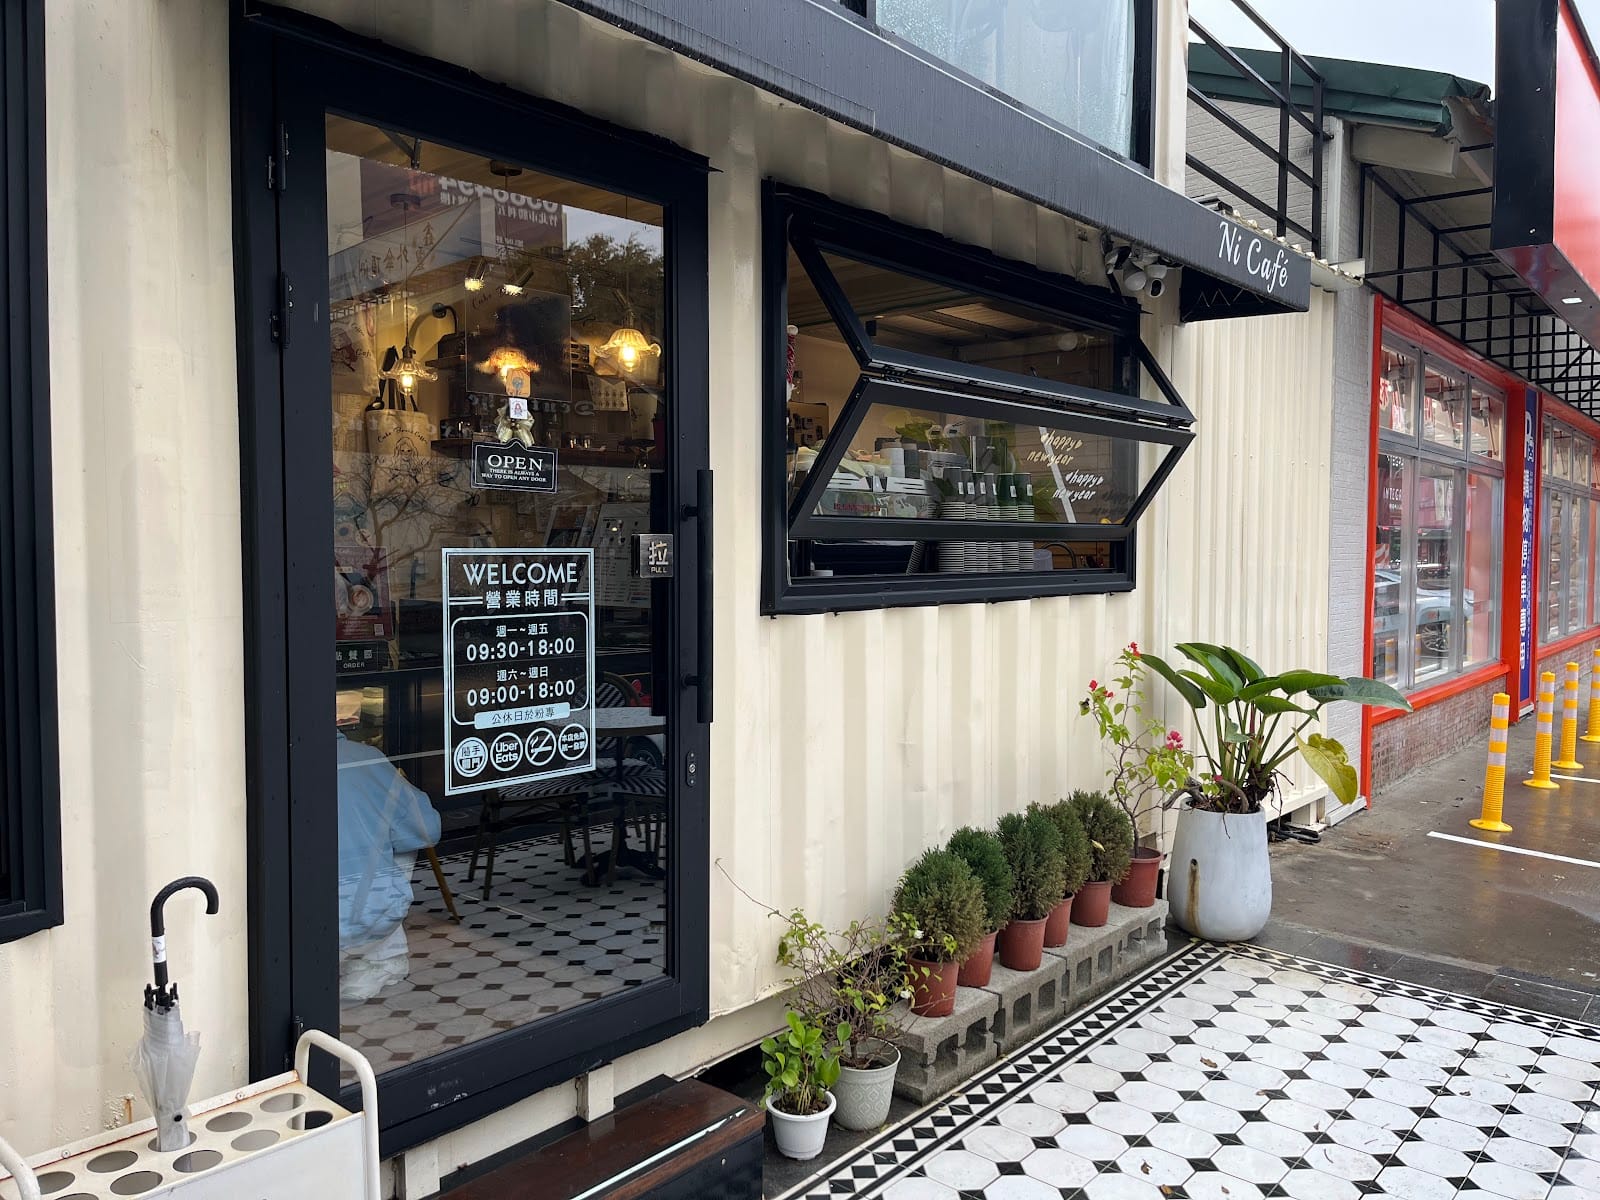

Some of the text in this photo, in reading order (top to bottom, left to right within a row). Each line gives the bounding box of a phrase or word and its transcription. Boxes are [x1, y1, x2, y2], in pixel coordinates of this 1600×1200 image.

[1218, 221, 1289, 293] Ni Café
[1046, 430, 1075, 451] happy
[487, 454, 544, 472] OPEN
[1027, 450, 1074, 467] new year
[1069, 469, 1098, 488] happy
[1052, 488, 1096, 502] new year
[648, 541, 669, 565] 拉
[463, 562, 578, 587] WELCOME
[485, 588, 559, 609] 營業時間
[466, 637, 575, 662] 09:30-18:00
[466, 679, 575, 707] 09:00-18:00
[491, 707, 555, 725] 公休日於粉專
[461, 745, 481, 757] 隨手
[495, 742, 518, 753] Uber
[495, 752, 519, 764] Eats
